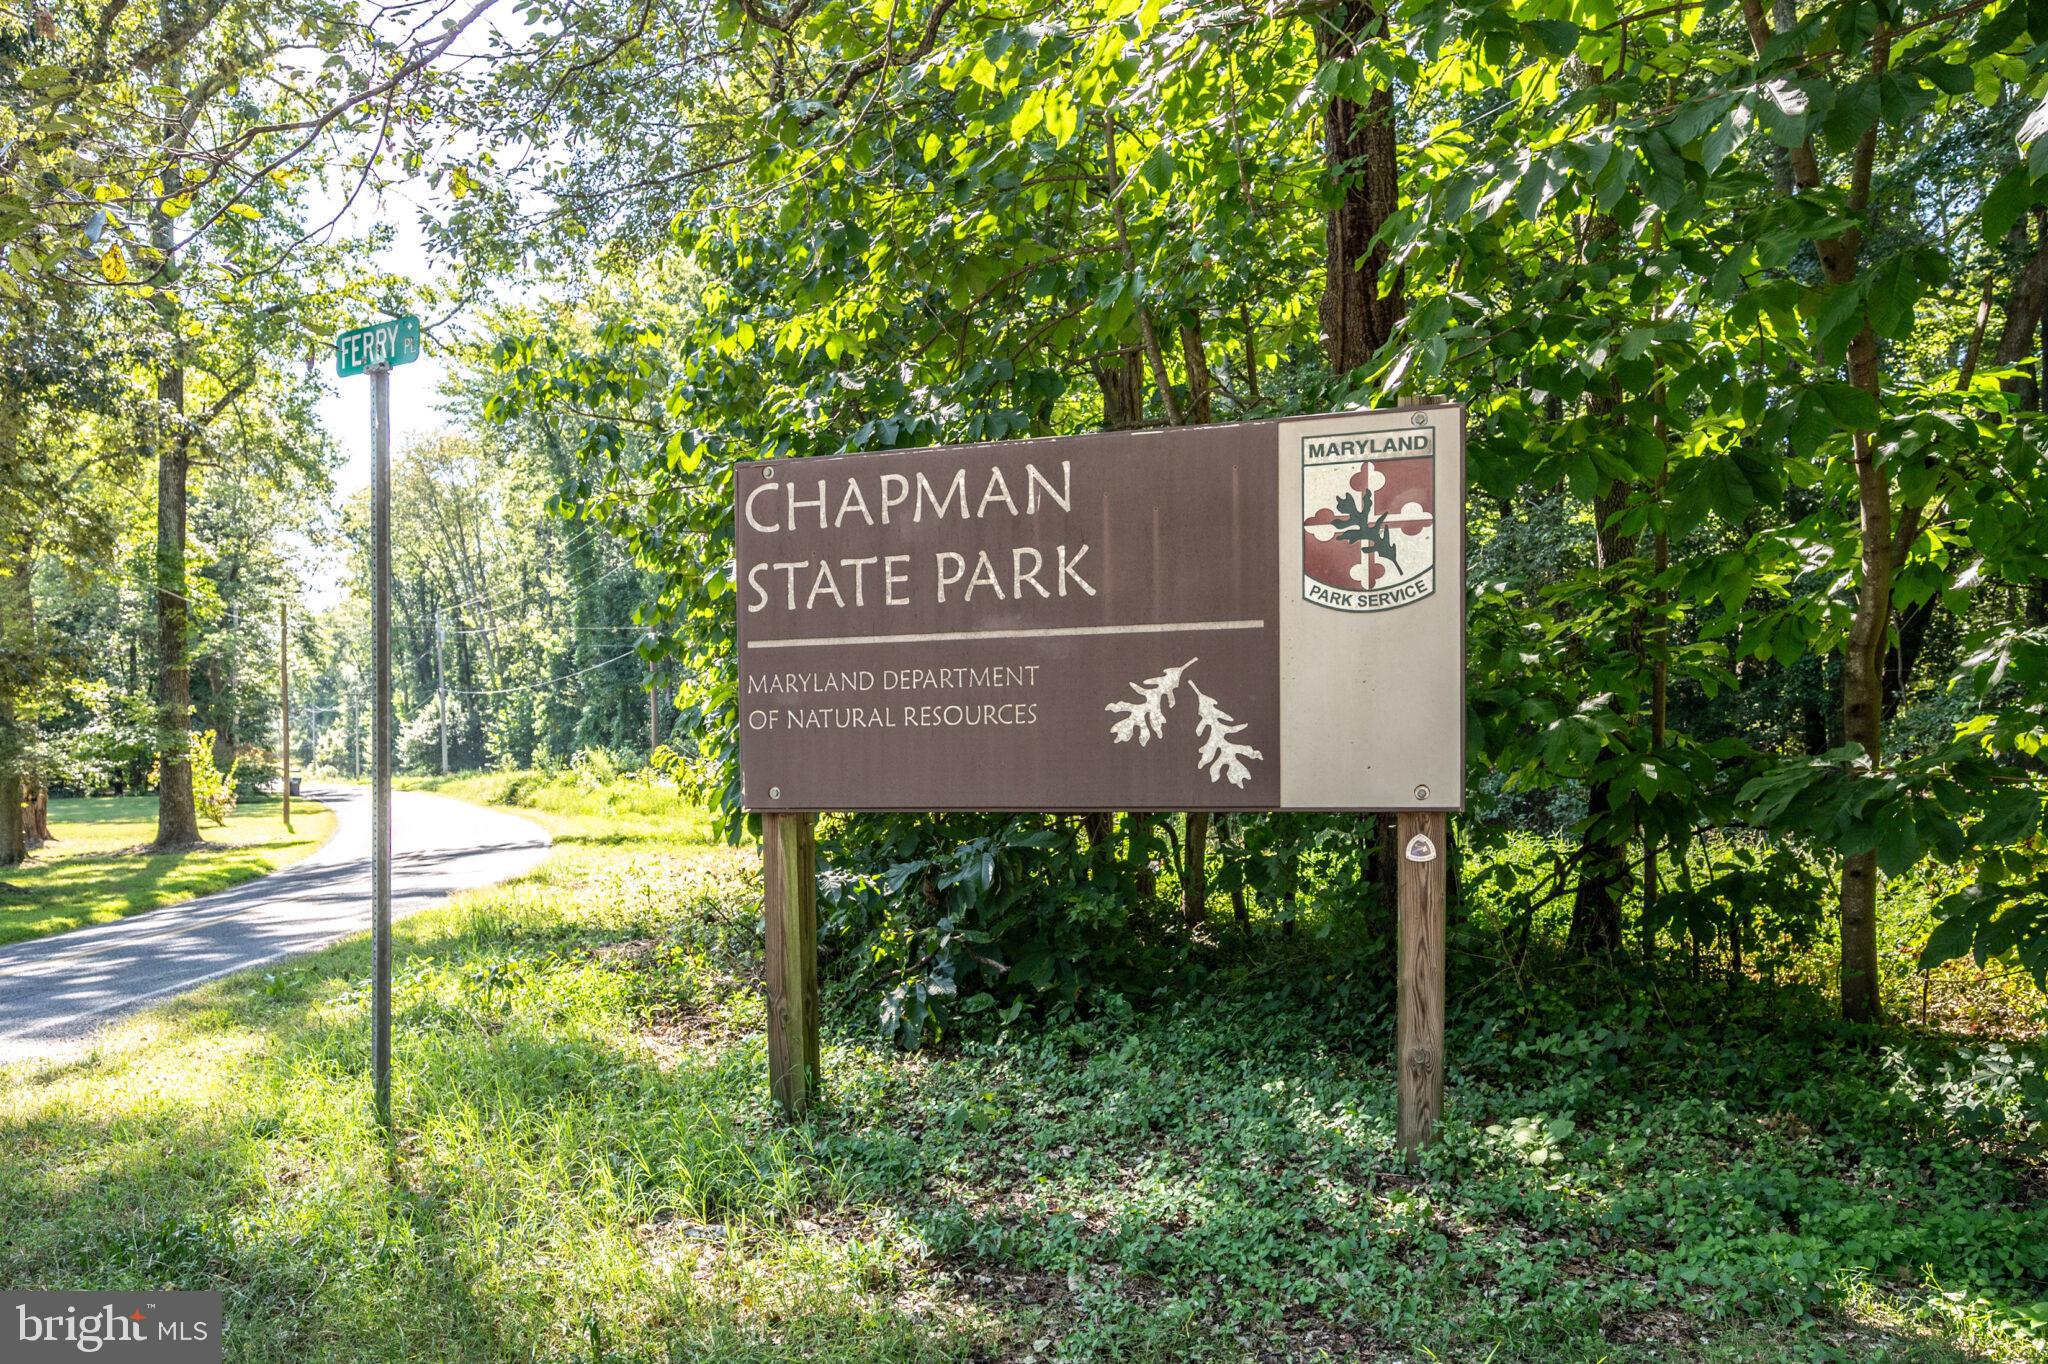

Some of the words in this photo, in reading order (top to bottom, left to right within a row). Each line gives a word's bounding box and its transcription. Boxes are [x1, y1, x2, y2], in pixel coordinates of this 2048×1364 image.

[341, 324, 399, 369] FERRY
[1308, 435, 1428, 459] MARYLAND
[745, 461, 1071, 533] CHAPMAN
[748, 555, 910, 613] STATE
[936, 544, 1096, 603] PARK
[1309, 585, 1353, 606] PARK
[1357, 579, 1428, 607] SERVICE
[748, 670, 874, 694] MARYLAND
[883, 665, 1040, 690] DEPARTMENT
[749, 710, 779, 730] OF
[787, 708, 896, 729] NATURAL
[904, 703, 1038, 727] RESOURCES
